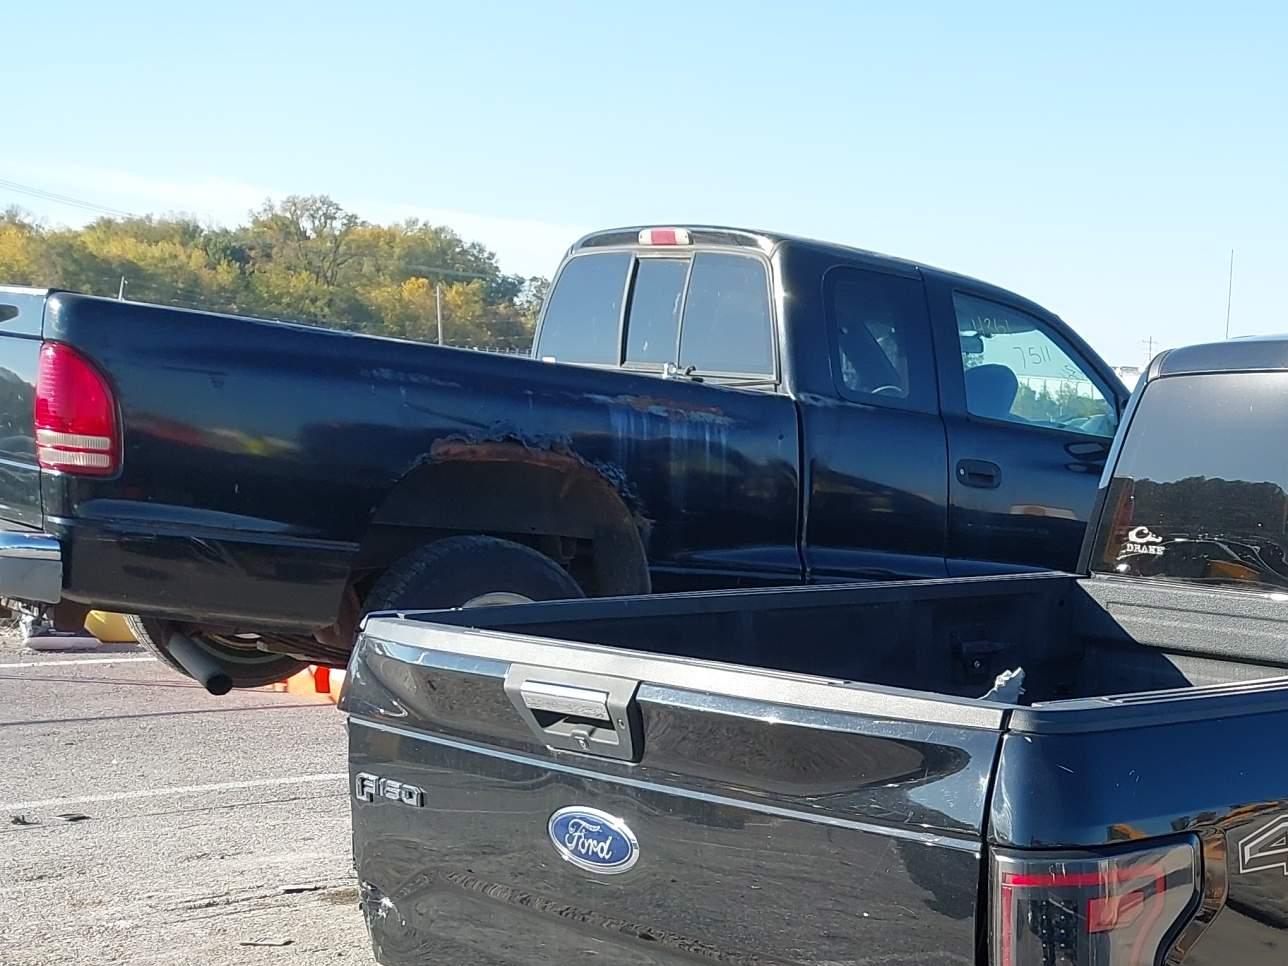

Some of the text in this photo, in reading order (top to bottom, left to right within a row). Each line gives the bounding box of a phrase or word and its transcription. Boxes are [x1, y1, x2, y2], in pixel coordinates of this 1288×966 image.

[1013, 345, 1052, 370] 7511
[1126, 543, 1166, 556] DRAKE
[563, 817, 613, 861] Ford
